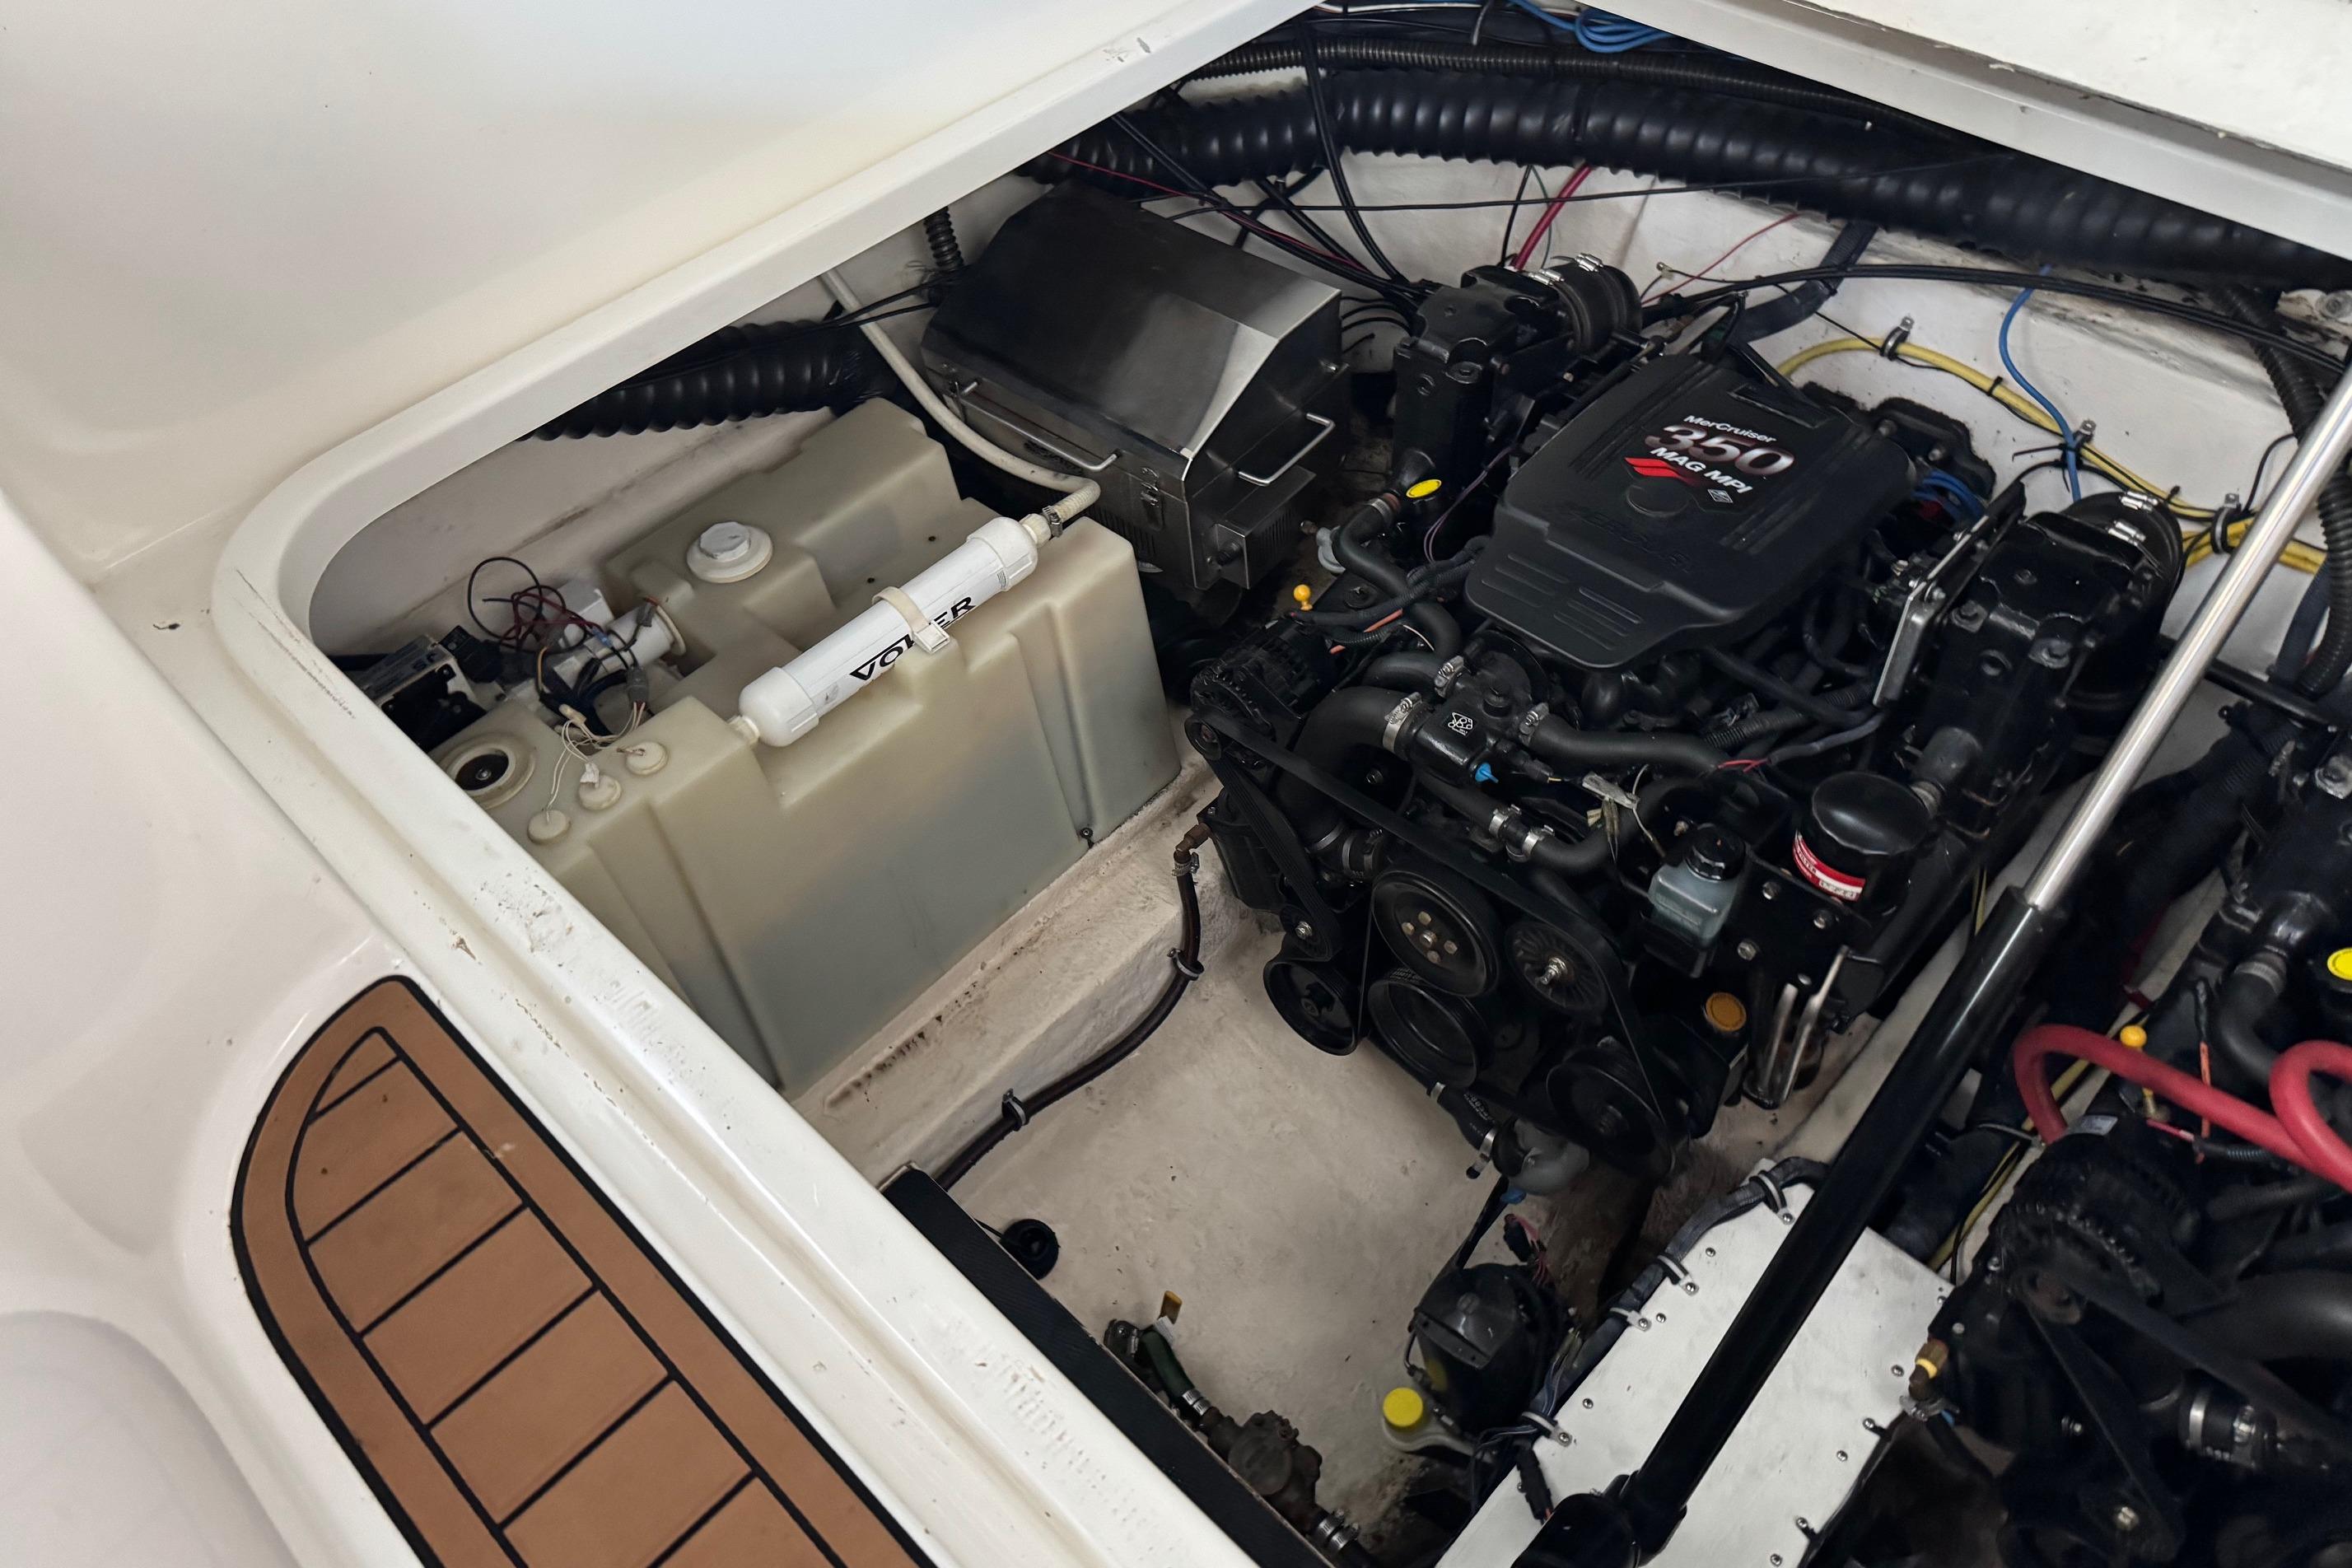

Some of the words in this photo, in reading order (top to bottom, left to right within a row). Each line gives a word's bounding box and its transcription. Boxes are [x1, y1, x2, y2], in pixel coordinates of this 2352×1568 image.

[1644, 422, 1795, 476] 350
[1682, 414, 1777, 444] MerCruiser
[1650, 446, 1707, 473] MAG
[1703, 469, 1753, 494] MPI
